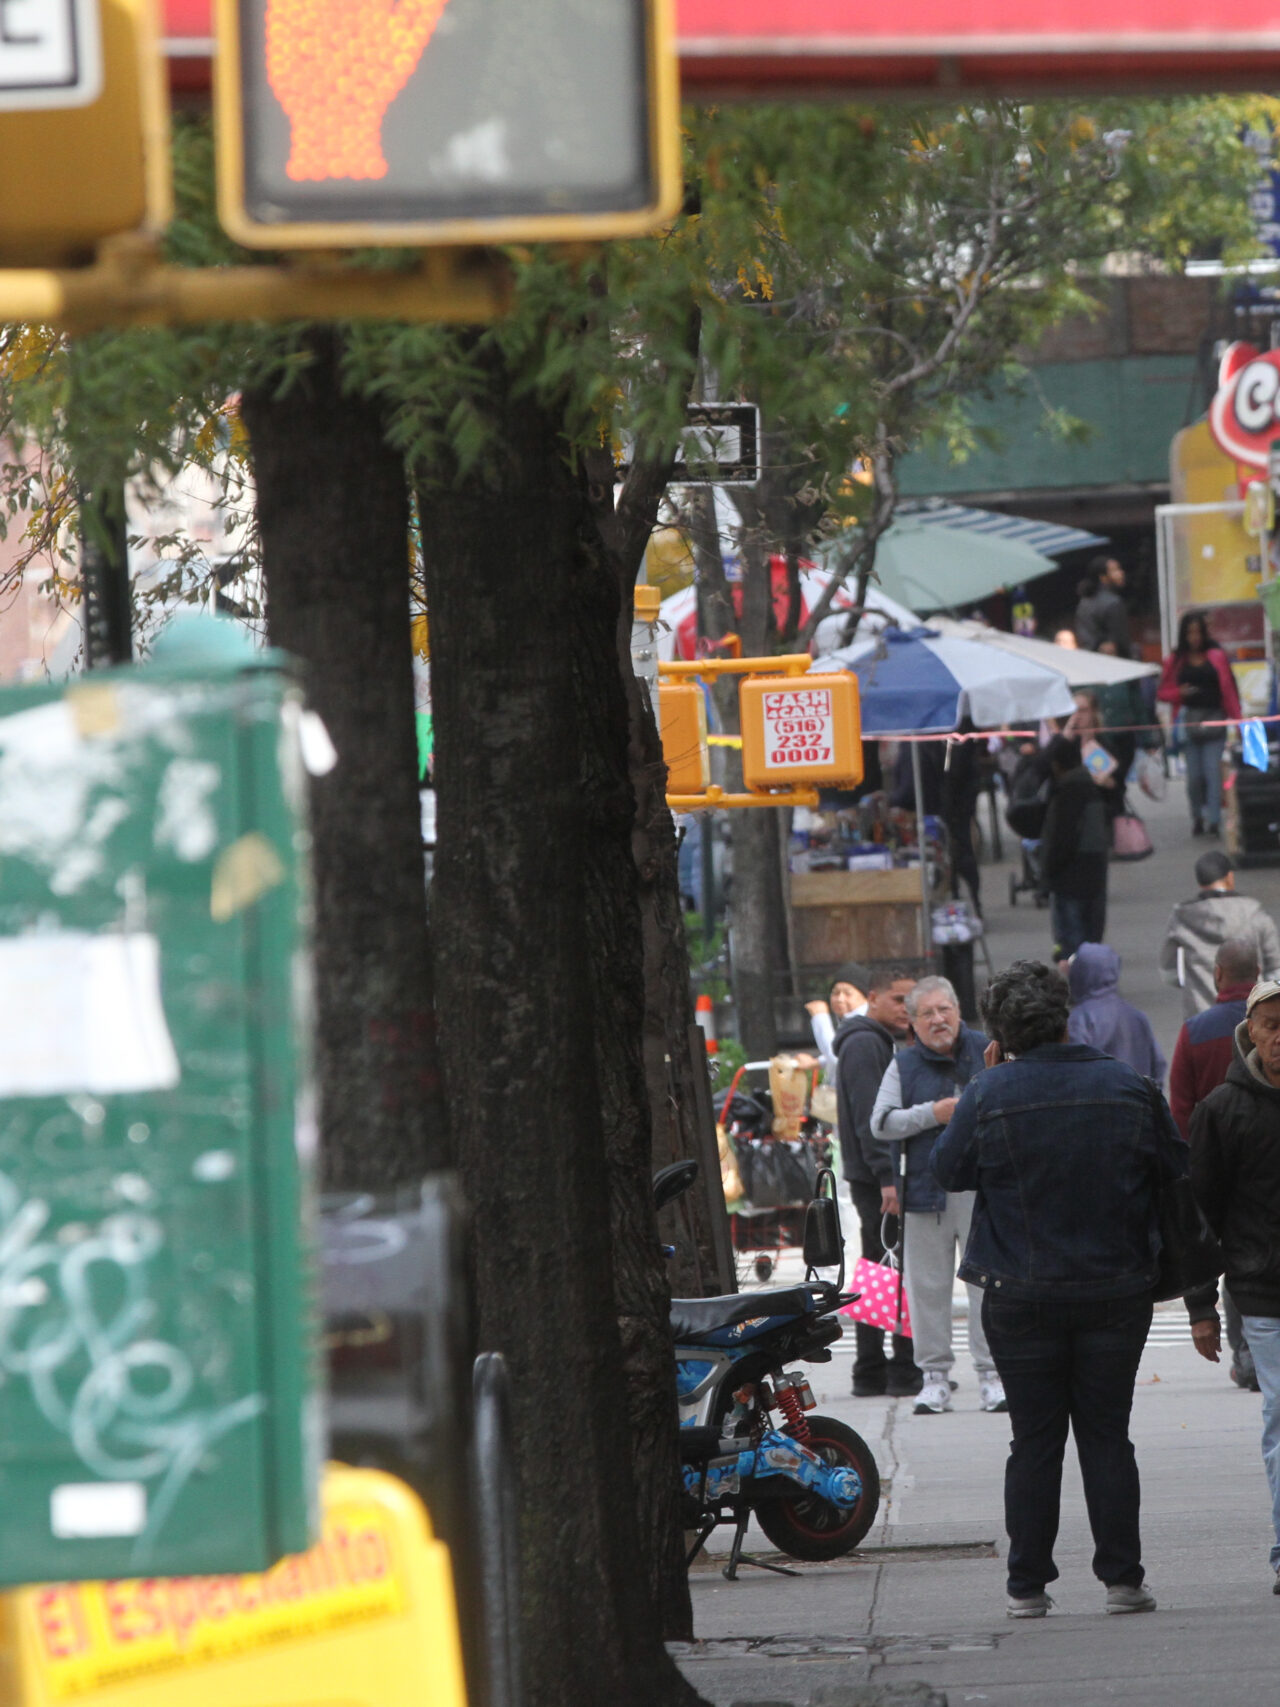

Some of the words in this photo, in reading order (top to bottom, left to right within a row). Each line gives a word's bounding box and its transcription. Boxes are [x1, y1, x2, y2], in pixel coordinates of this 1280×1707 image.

[774, 718, 825, 735] (516)
[777, 733, 822, 749] 232
[771, 747, 831, 764] 0007
